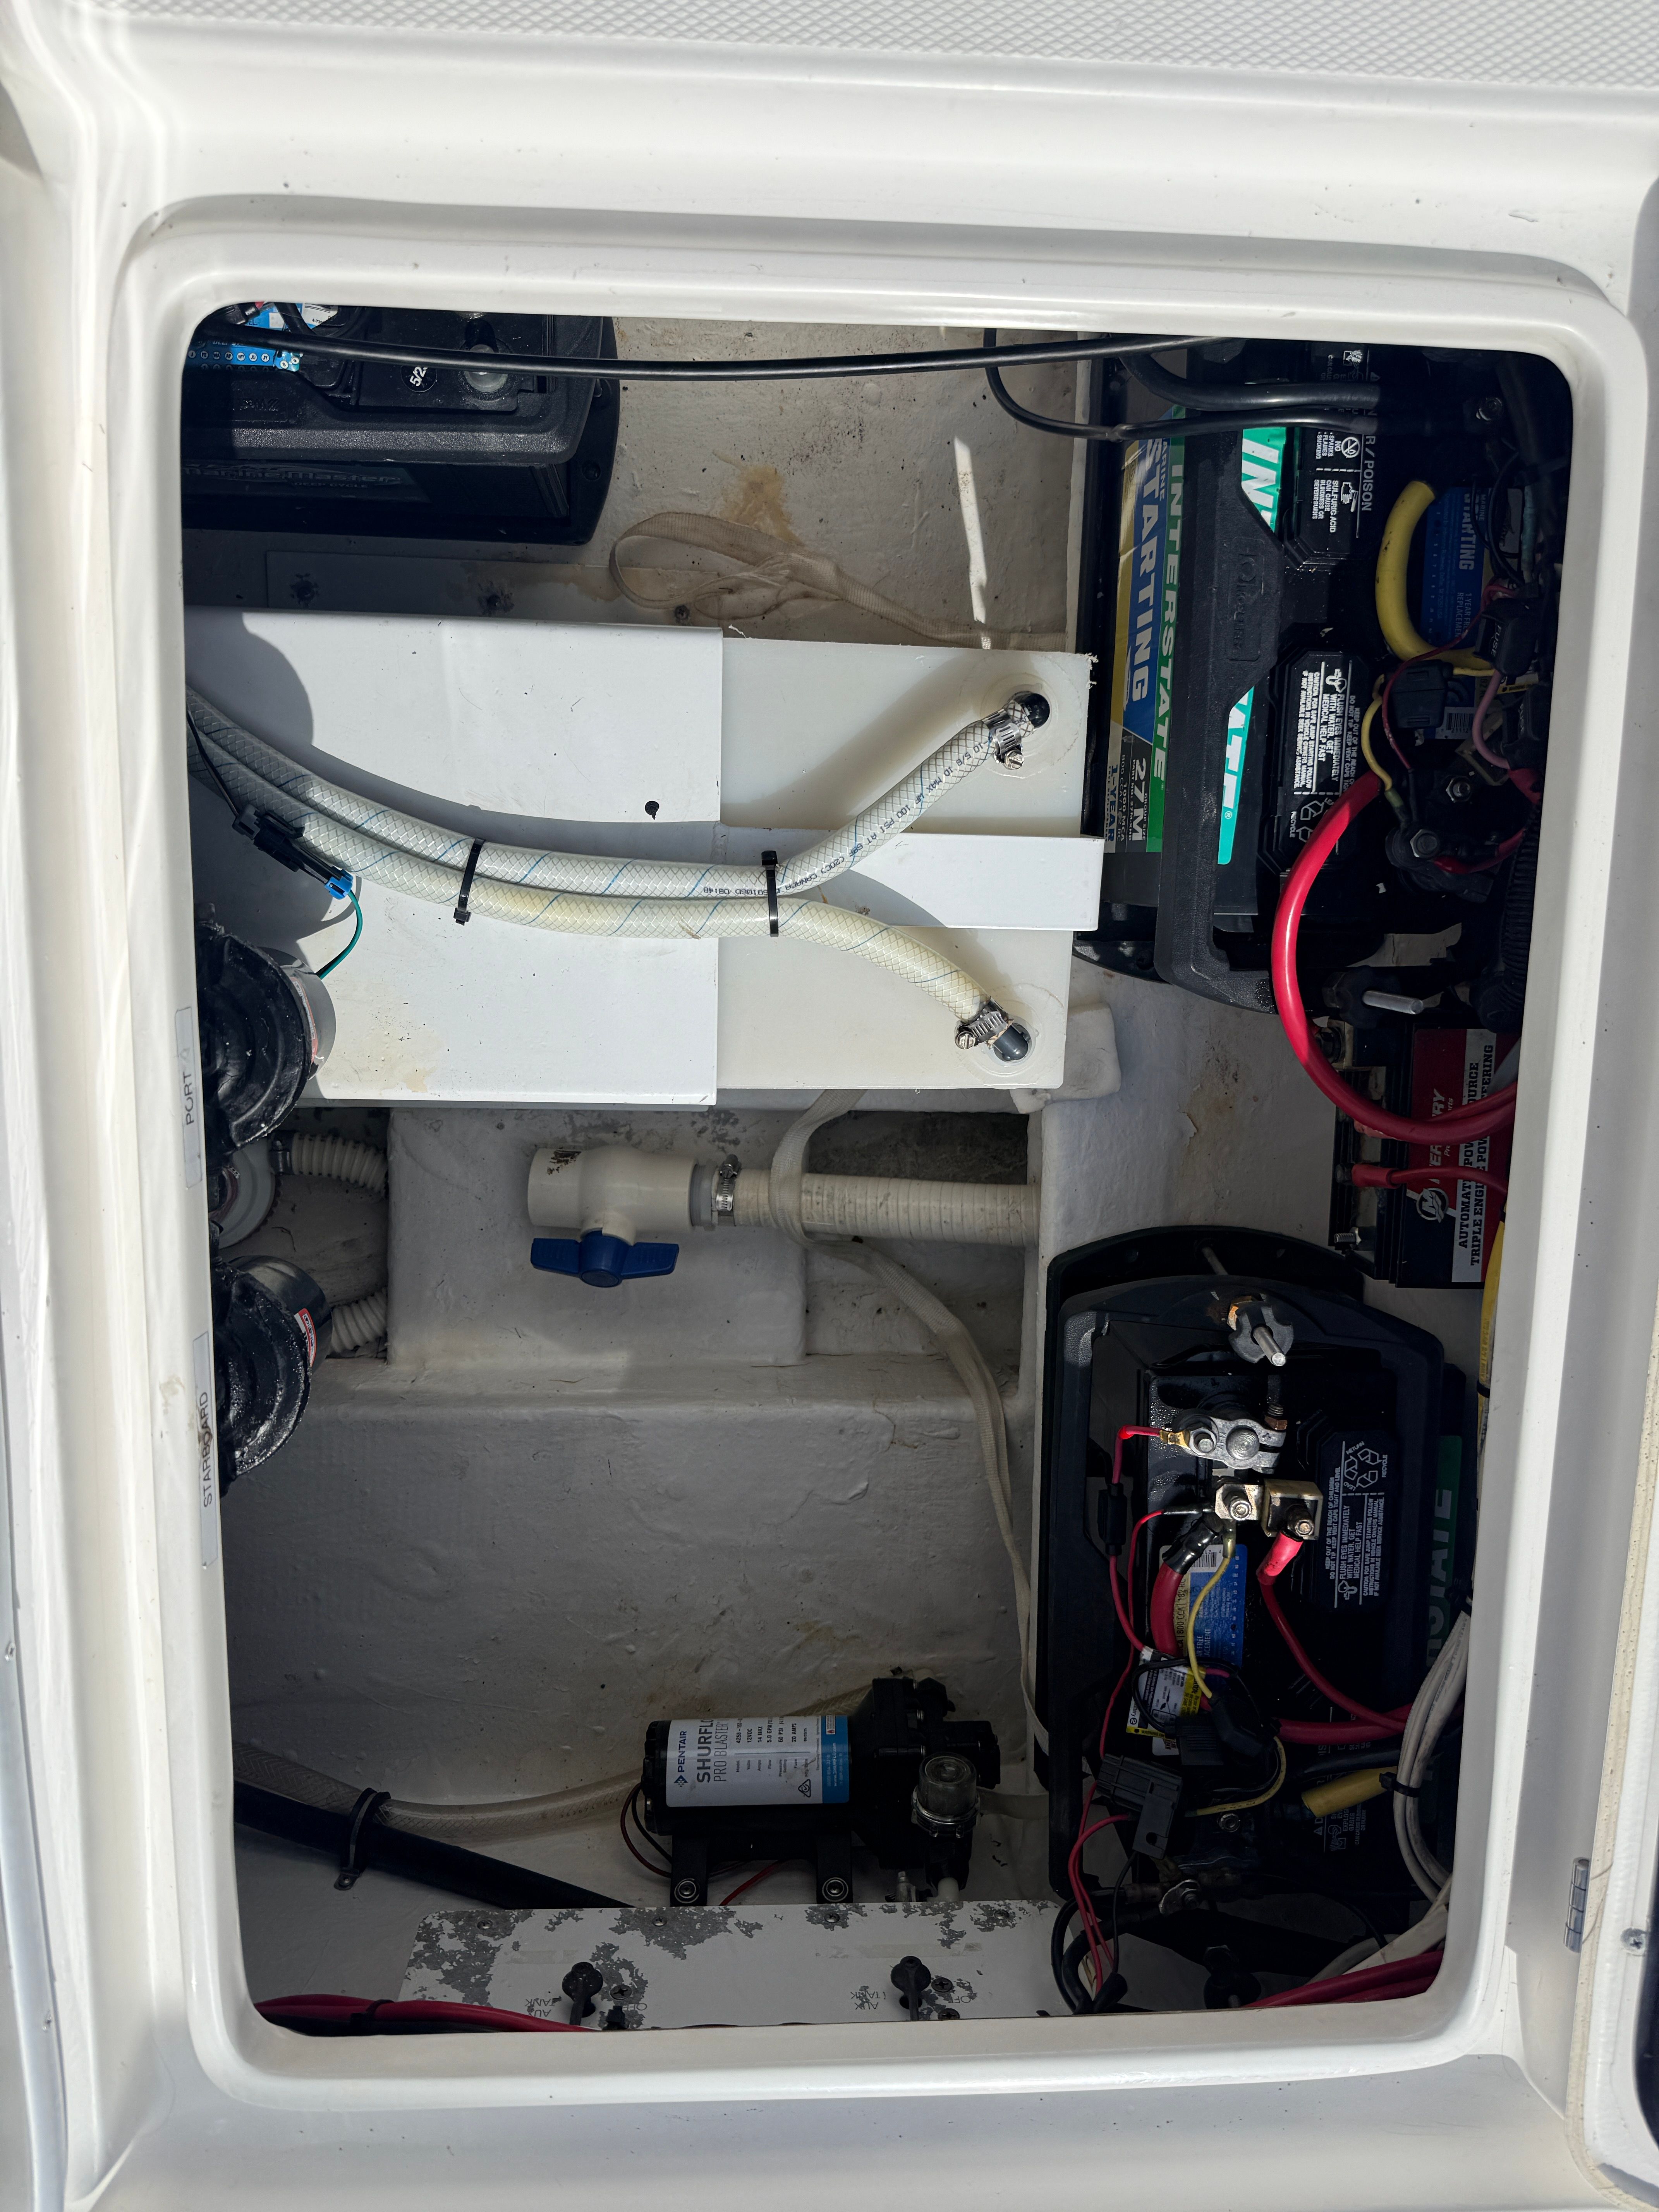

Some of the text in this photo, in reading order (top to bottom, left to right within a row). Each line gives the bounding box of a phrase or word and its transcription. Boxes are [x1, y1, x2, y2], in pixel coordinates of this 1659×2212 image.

[1334, 441, 1341, 452] NO
[1361, 460, 1374, 511] POISON
[1318, 510, 1325, 519] OR
[1329, 480, 1340, 534] SULFURIC ACID
[1132, 438, 1163, 702] STARTING
[1454, 592, 1464, 637] REPLACEMEN
[1491, 625, 1501, 657] FUSE
[1329, 693, 1337, 712] WITH
[1318, 693, 1329, 762] MEDICAL HELP FAST
[1331, 694, 1345, 782] FLUSH EYES IMMEDIATELY
[1326, 740, 1334, 754] GET
[1352, 736, 1358, 745] OF
[944, 766, 953, 777] ID
[956, 752, 972, 766] 5/8
[926, 776, 942, 793] MAX
[896, 805, 911, 819] 100
[1108, 764, 1118, 842] 1-YEAR
[1132, 757, 1146, 842] 27M
[879, 817, 895, 833] PSI
[1116, 828, 1121, 842] RC
[848, 843, 864, 858] 68F
[866, 833, 878, 845] AT
[785, 873, 818, 890] CANADA
[183, 1071, 194, 1125] PORT
[1470, 1219, 1483, 1266] TRIPLE
[200, 1391, 212, 1508] STARBOARD
[1341, 1505, 1350, 1543] IMMEDIATELY
[677, 1731, 687, 1772] PENTAIR
[714, 1723, 729, 1781] PRO BLASTER
[854, 2002, 879, 2010] AUX
